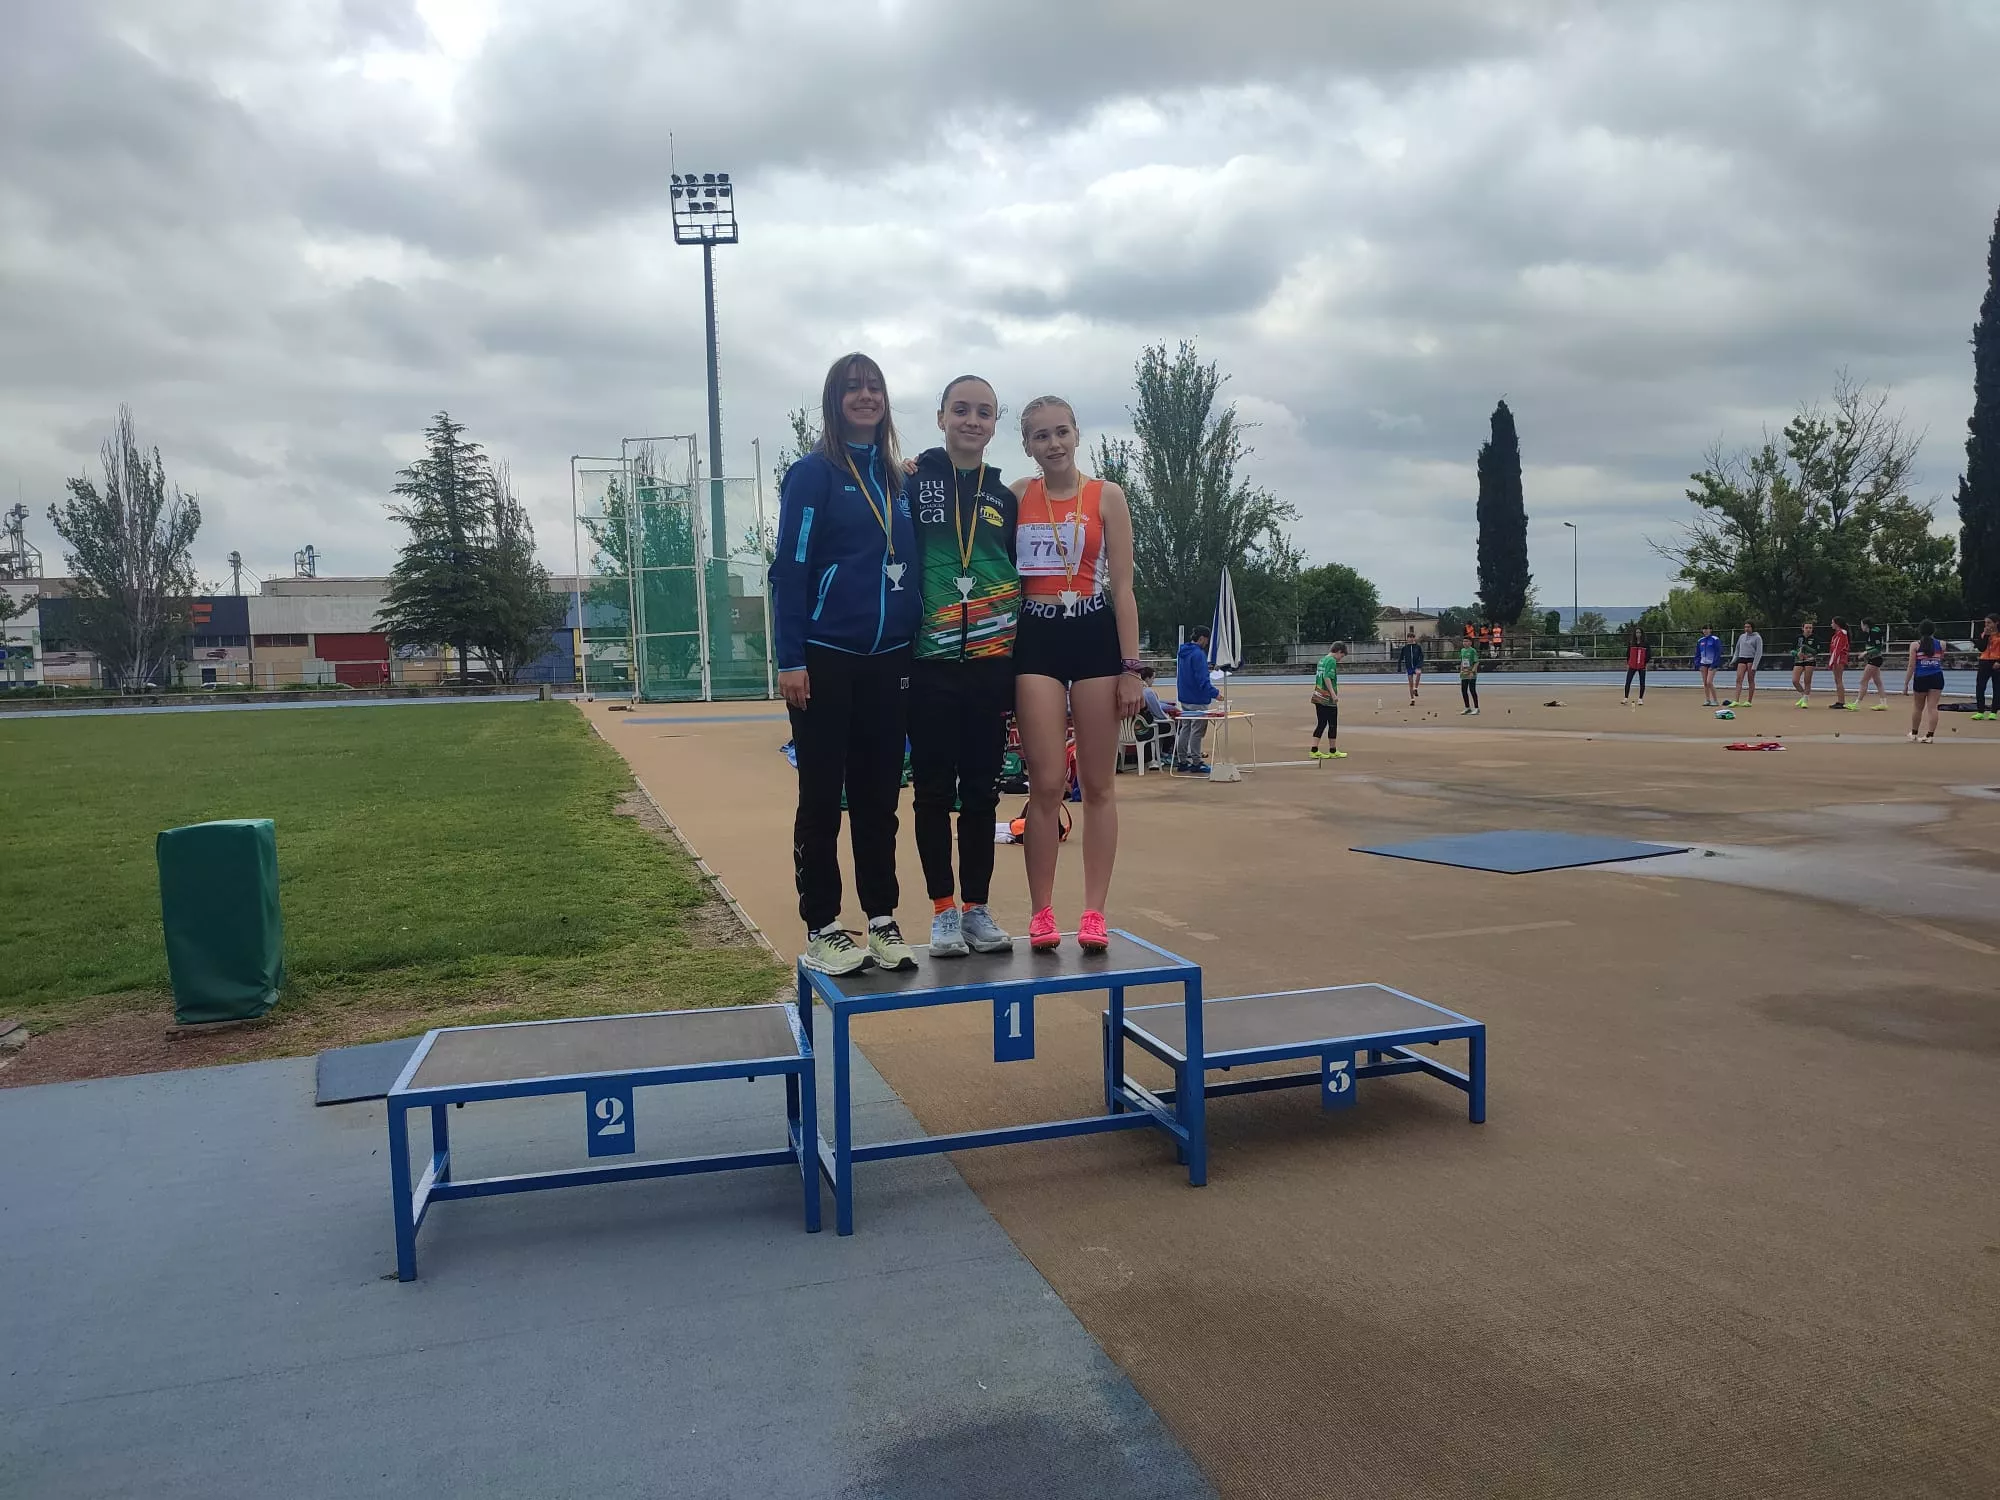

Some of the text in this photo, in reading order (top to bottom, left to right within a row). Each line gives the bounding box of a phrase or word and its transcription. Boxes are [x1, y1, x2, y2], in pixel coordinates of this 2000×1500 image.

[919, 490, 945, 503] es
[919, 508, 947, 524] ca
[1030, 540, 1068, 557] 776
[1022, 600, 1057, 619] PRO
[1004, 1002, 1022, 1038] 1
[1328, 1060, 1351, 1093] 3
[595, 1097, 626, 1136] 2
